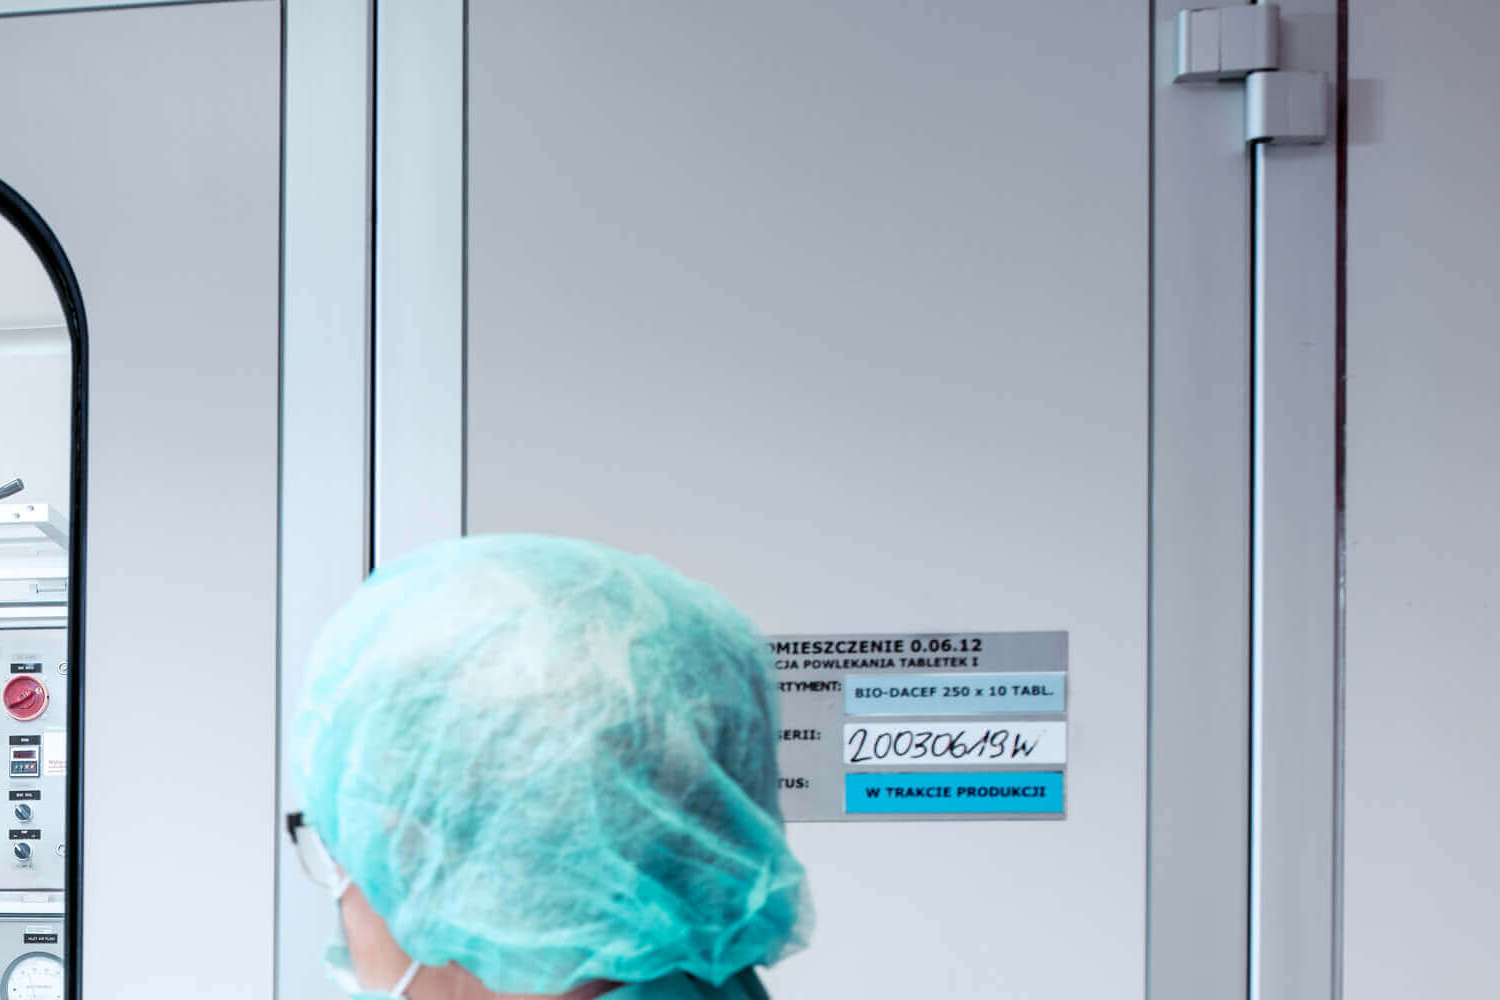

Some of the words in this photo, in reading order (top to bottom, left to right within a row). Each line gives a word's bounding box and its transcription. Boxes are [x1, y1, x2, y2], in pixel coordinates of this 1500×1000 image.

[770, 640, 905, 655] MIESZCZENIE
[910, 638, 983, 653] 0.06.12
[803, 658, 896, 670] POWLEKANIA
[900, 656, 968, 668] TABLETEK
[971, 656, 980, 668] I
[854, 686, 937, 699] BIO-DACEF
[943, 685, 971, 698] 250
[975, 688, 984, 697] x
[989, 685, 1008, 697] 10
[1011, 684, 1055, 697] TABL.
[865, 786, 881, 799] W
[885, 785, 952, 799] TRAKCIE
[956, 785, 1047, 798] PRODUKCJI
